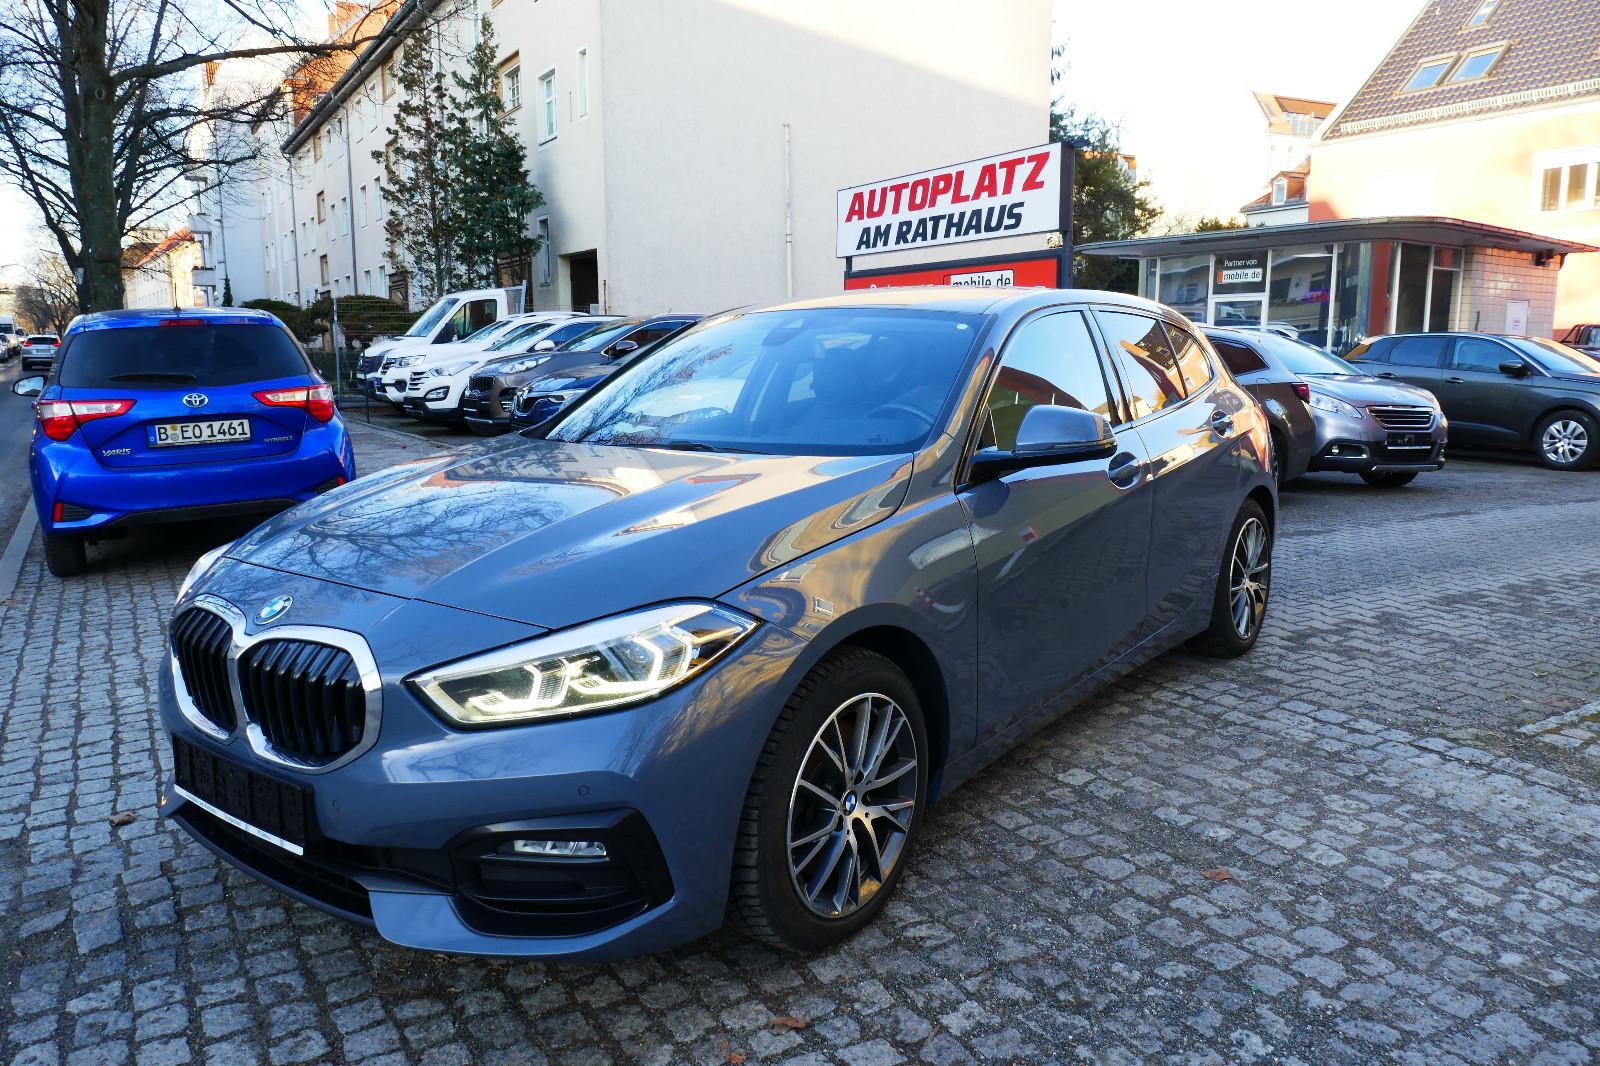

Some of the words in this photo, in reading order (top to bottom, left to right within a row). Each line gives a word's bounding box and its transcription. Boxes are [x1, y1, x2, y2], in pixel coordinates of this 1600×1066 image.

[844, 151, 1051, 223] AUTOPLATZ
[855, 223, 892, 250] AM
[894, 201, 1025, 246] RATHAUS
[1224, 259, 1245, 267] Partner
[952, 273, 1011, 287] bilede
[1223, 270, 1261, 281] mobile.de
[157, 426, 169, 441] B
[206, 421, 248, 438] 1461
[102, 448, 131, 457] YARIS
